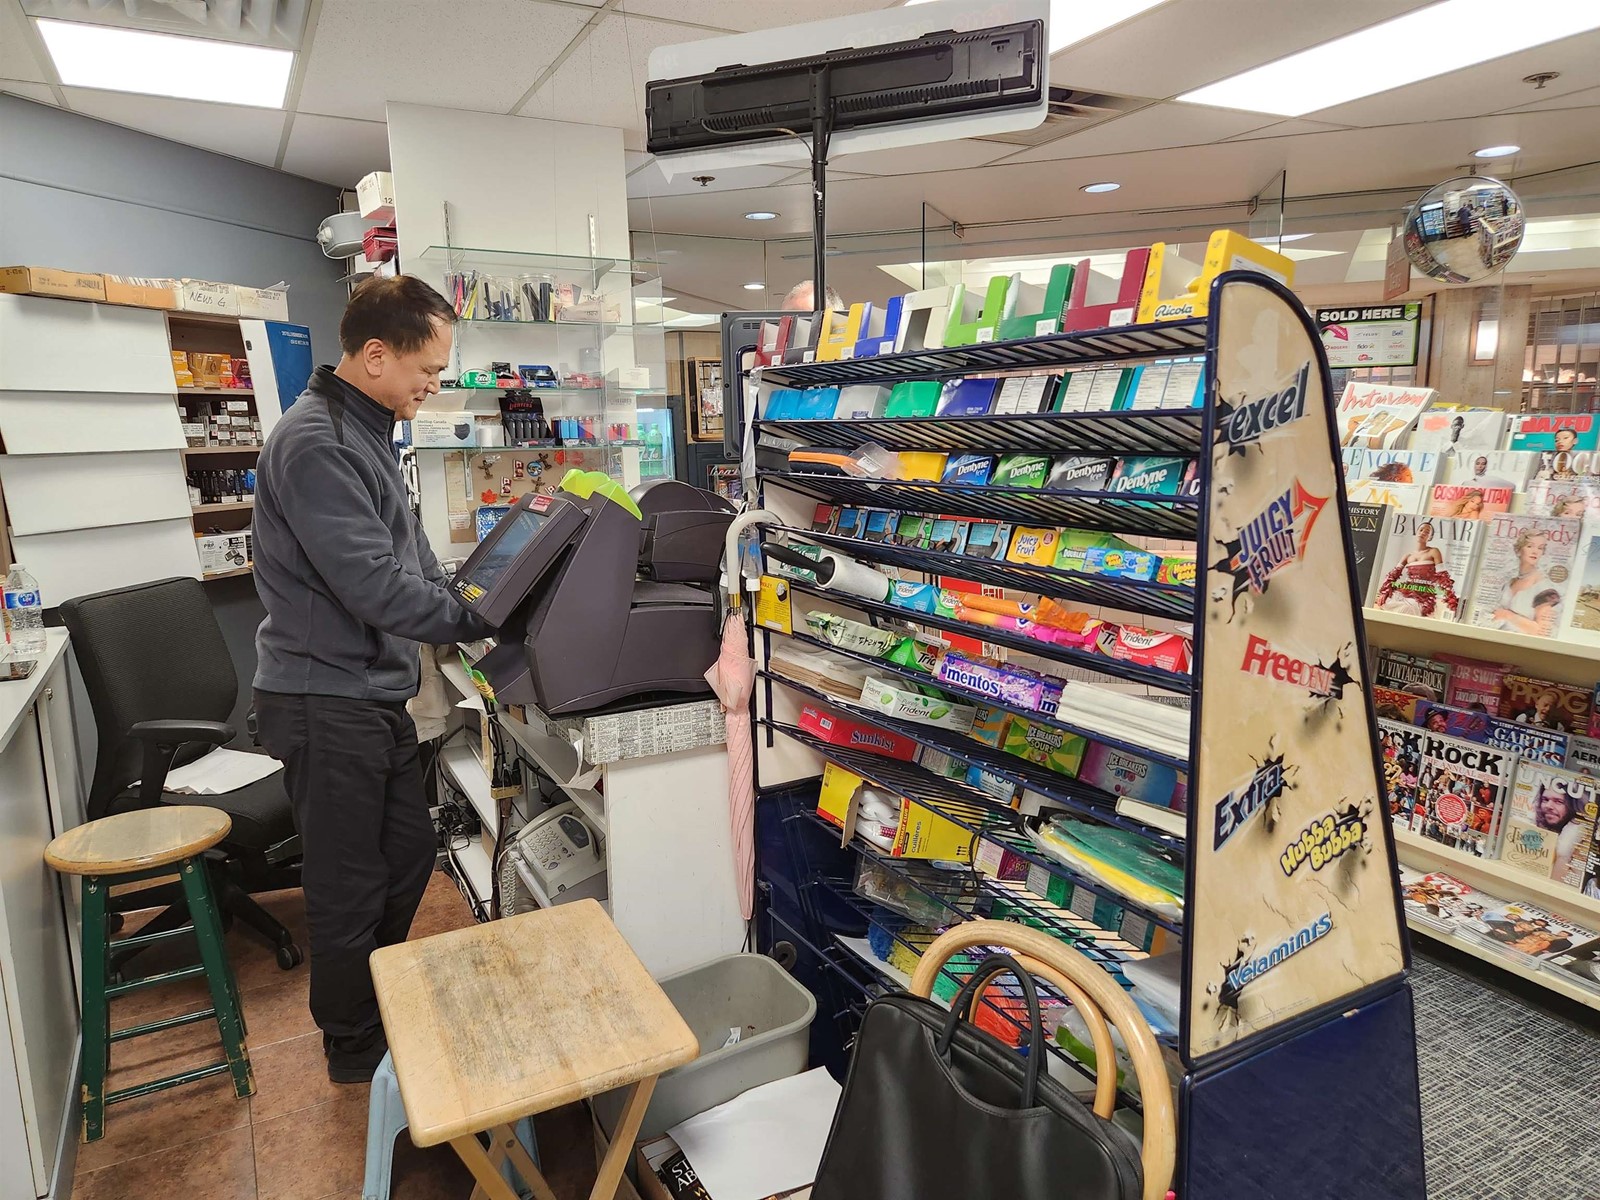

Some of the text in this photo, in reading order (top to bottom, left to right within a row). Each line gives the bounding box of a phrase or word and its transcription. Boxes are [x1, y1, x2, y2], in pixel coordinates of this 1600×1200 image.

[1154, 304, 1193, 317] Ricola
[1320, 307, 1402, 322] SOLD HERE
[1229, 361, 1311, 443] excel
[957, 460, 989, 475] Dentyne
[975, 467, 985, 476] Ice
[1010, 461, 1044, 478] Dentyne
[1066, 461, 1106, 481] Dentyne
[1364, 451, 1435, 472] VOGUE
[1029, 469, 1041, 478] Ice
[1090, 472, 1103, 483] Ice
[1116, 468, 1168, 492] Dentyne
[1434, 485, 1510, 504] COSMOLITAN
[1238, 487, 1294, 565] JUICY
[1493, 518, 1577, 546] The Lady
[1016, 544, 1036, 556] Fruit
[1017, 534, 1039, 547] Juicy
[1248, 528, 1297, 592] FRUIT
[898, 586, 915, 595] Trident
[1123, 632, 1153, 646] Trident
[946, 667, 1000, 696] mentos
[1387, 661, 1419, 684] VINTAGE
[1423, 670, 1443, 690] ROCK
[1455, 691, 1500, 706] TAYLOR SWIFT
[1510, 681, 1589, 713] PROG
[899, 704, 929, 718] Trident
[850, 730, 895, 753] Sunkist
[1027, 726, 1063, 749] ICE BREAKERS
[1030, 740, 1054, 754] SOURS
[1378, 728, 1423, 755] OCK
[1448, 742, 1475, 753] CLASSIC
[1494, 727, 1557, 753] GARTH
[1424, 736, 1503, 777] ROCK
[1488, 738, 1561, 766] BROOKS
[1109, 753, 1148, 776] ICE BREAKERS
[1114, 768, 1136, 782] DUO
[1440, 760, 1476, 777] ANNUAL
[1519, 765, 1597, 803] UNCUT
[1213, 765, 1281, 851] Extra
[1280, 815, 1336, 877] Hubba
[1309, 820, 1364, 871] Bubba
[1515, 843, 1549, 858] World
[1514, 903, 1596, 939] FLEETWOOD MAC
[1226, 911, 1334, 991] Velamints
